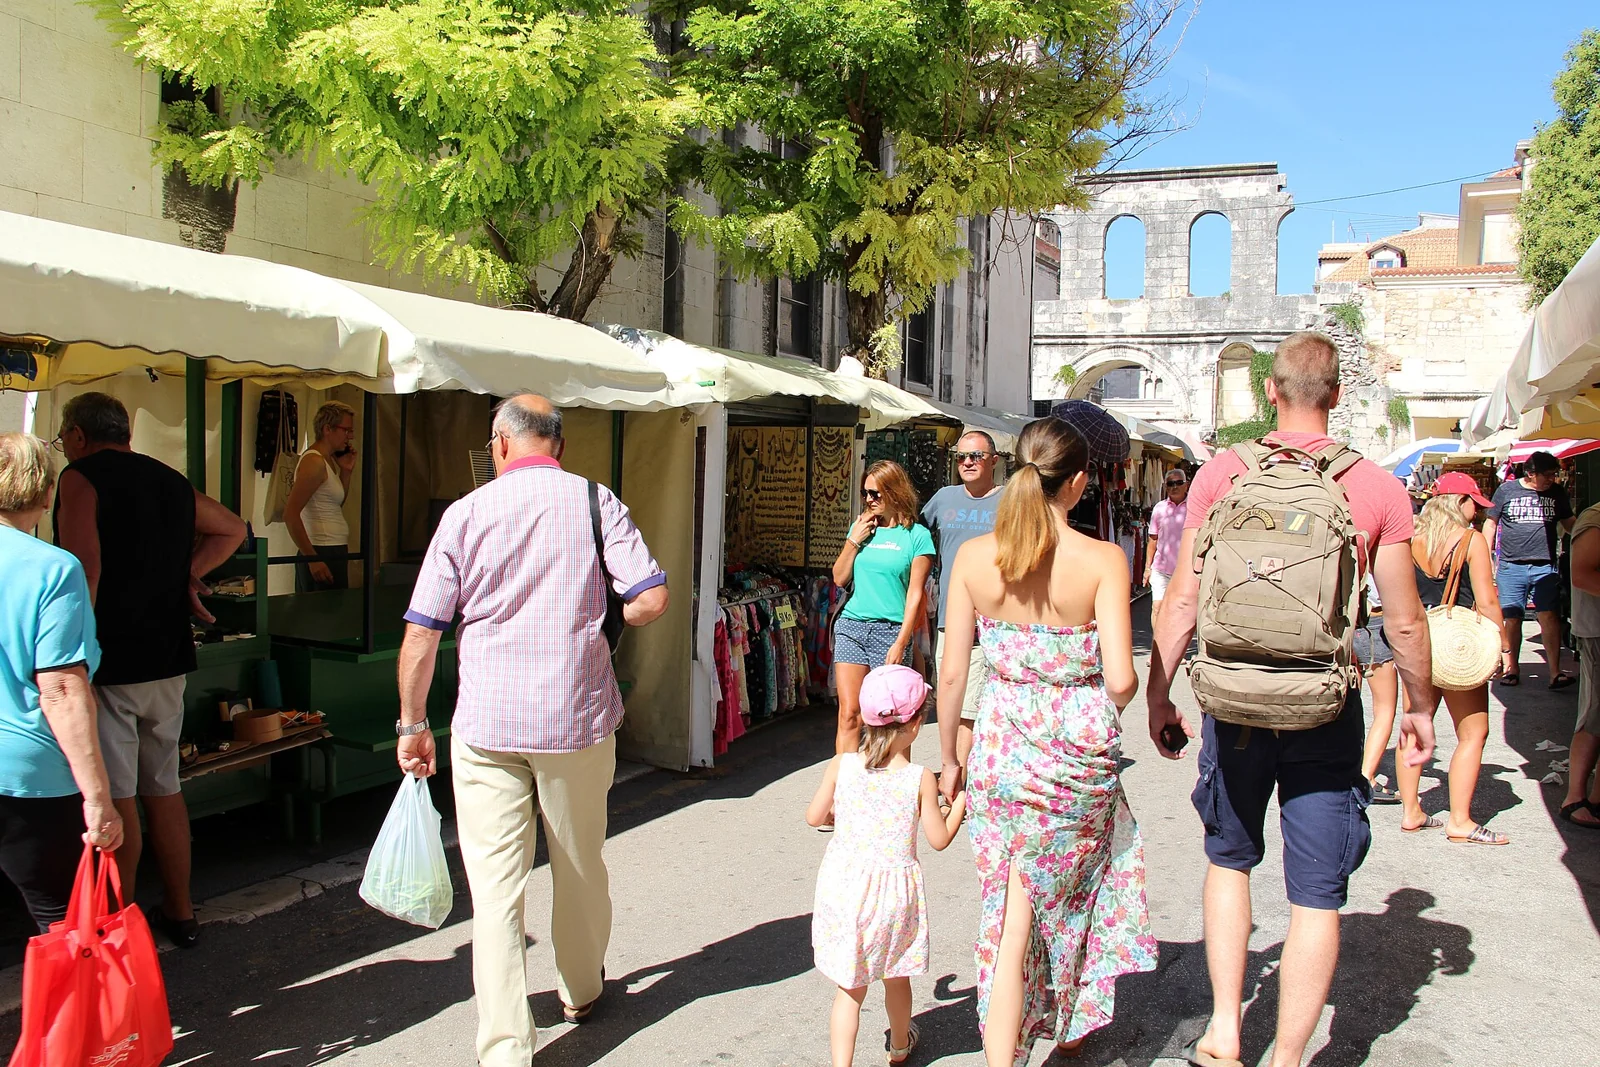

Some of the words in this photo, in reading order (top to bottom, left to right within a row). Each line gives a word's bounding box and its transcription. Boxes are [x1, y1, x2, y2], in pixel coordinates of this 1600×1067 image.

[1509, 497, 1532, 506] BLUE
[1508, 506, 1556, 516] SUPERIOR
[943, 509, 996, 525] OSAK
[1267, 559, 1276, 568] A
